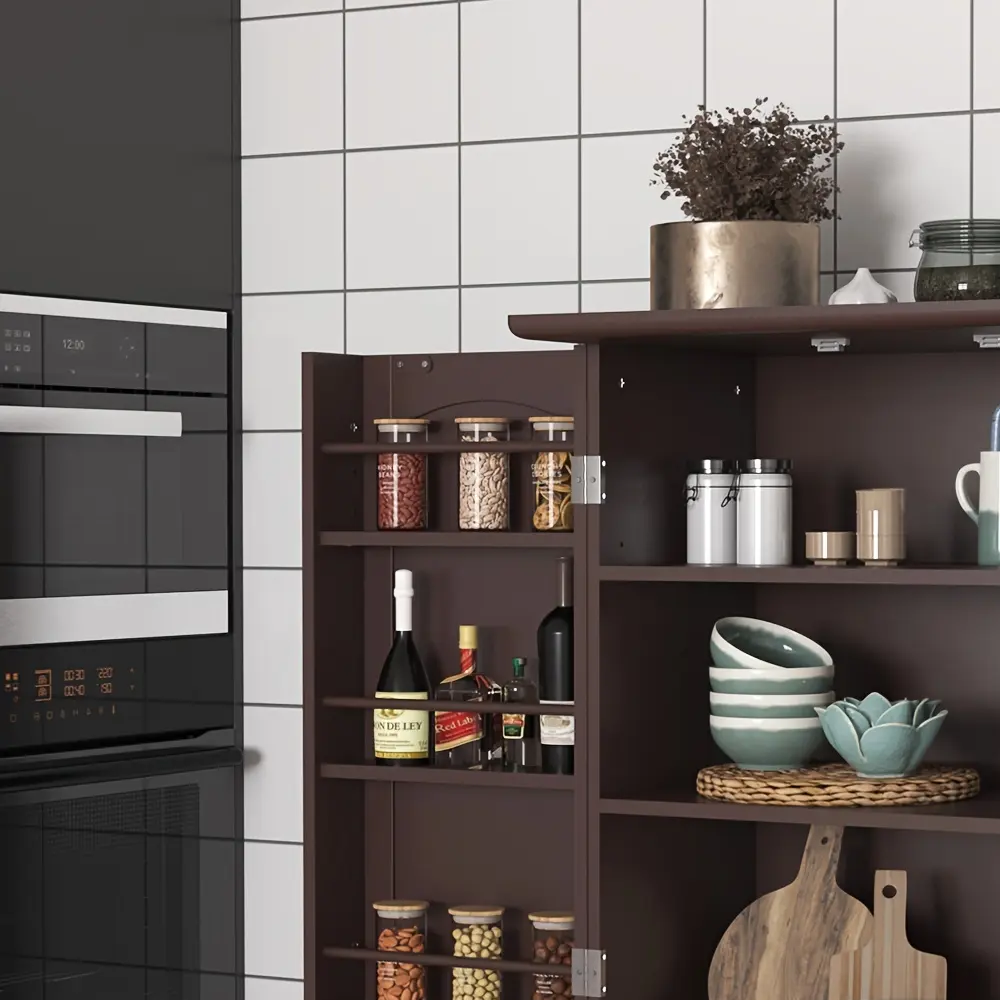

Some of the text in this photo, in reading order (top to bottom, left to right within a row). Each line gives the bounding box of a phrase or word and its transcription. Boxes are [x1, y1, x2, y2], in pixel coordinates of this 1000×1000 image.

[62, 339, 85, 350] 12:00
[386, 721, 401, 731] DE
[403, 720, 422, 731] LEY
[435, 724, 456, 733] Red
